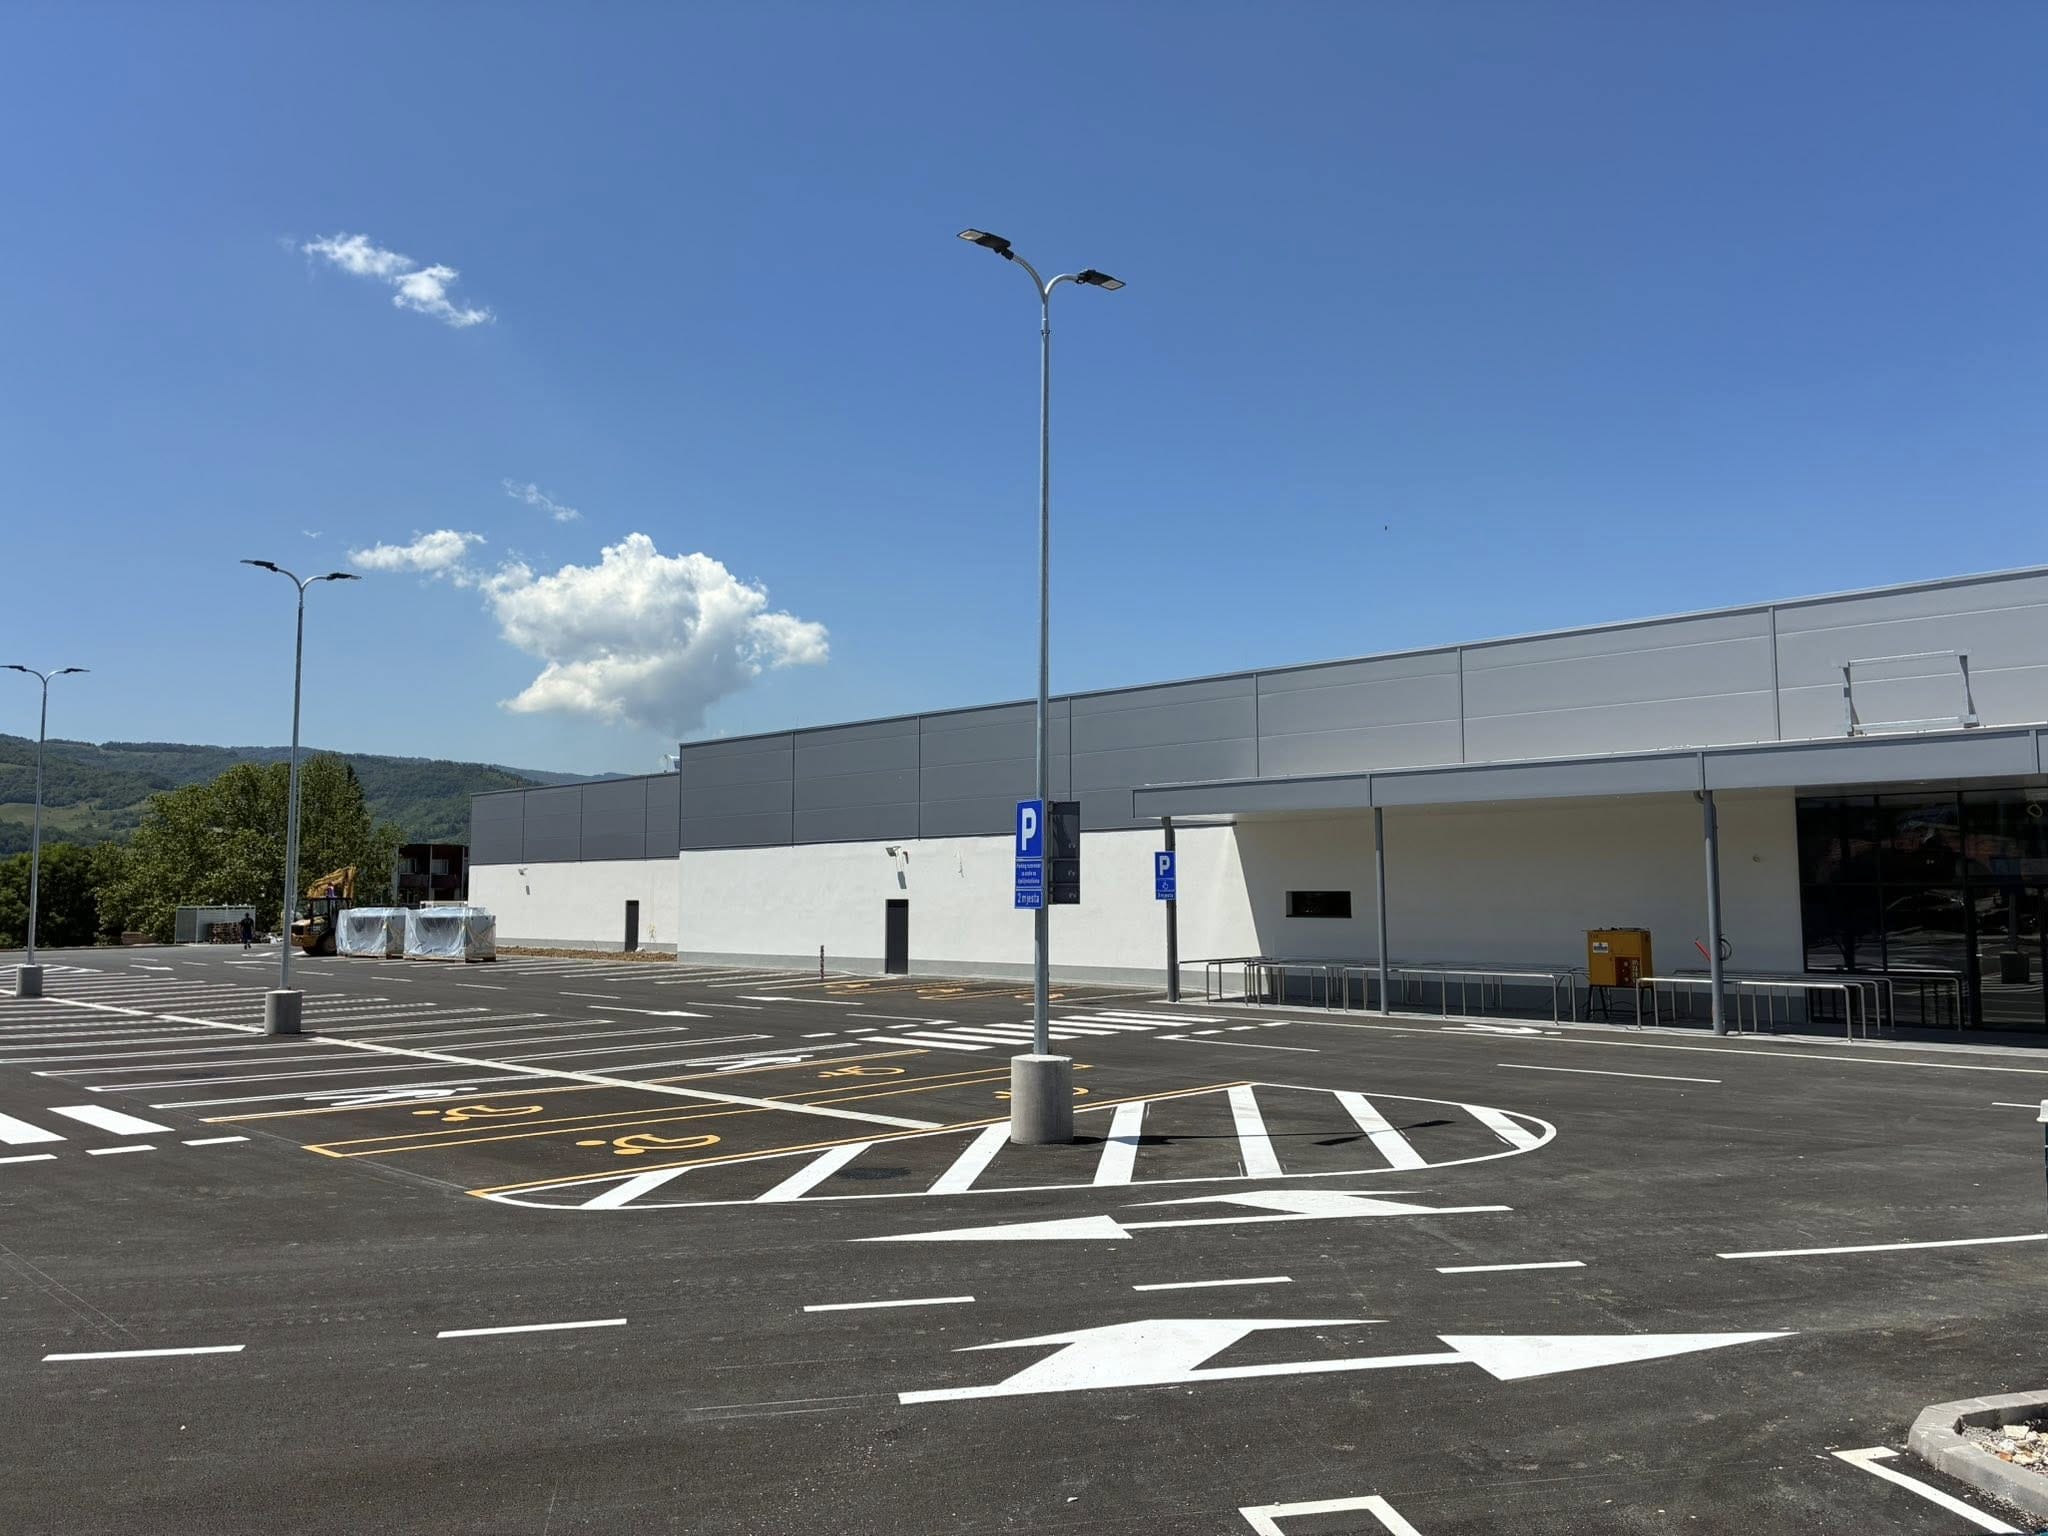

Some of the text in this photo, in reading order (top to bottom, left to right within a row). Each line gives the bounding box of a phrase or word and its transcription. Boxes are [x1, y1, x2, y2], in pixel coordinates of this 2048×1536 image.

[1021, 807, 1037, 851] P
[1159, 855, 1170, 876] P
[1017, 892, 1040, 905] 2 mjesta
